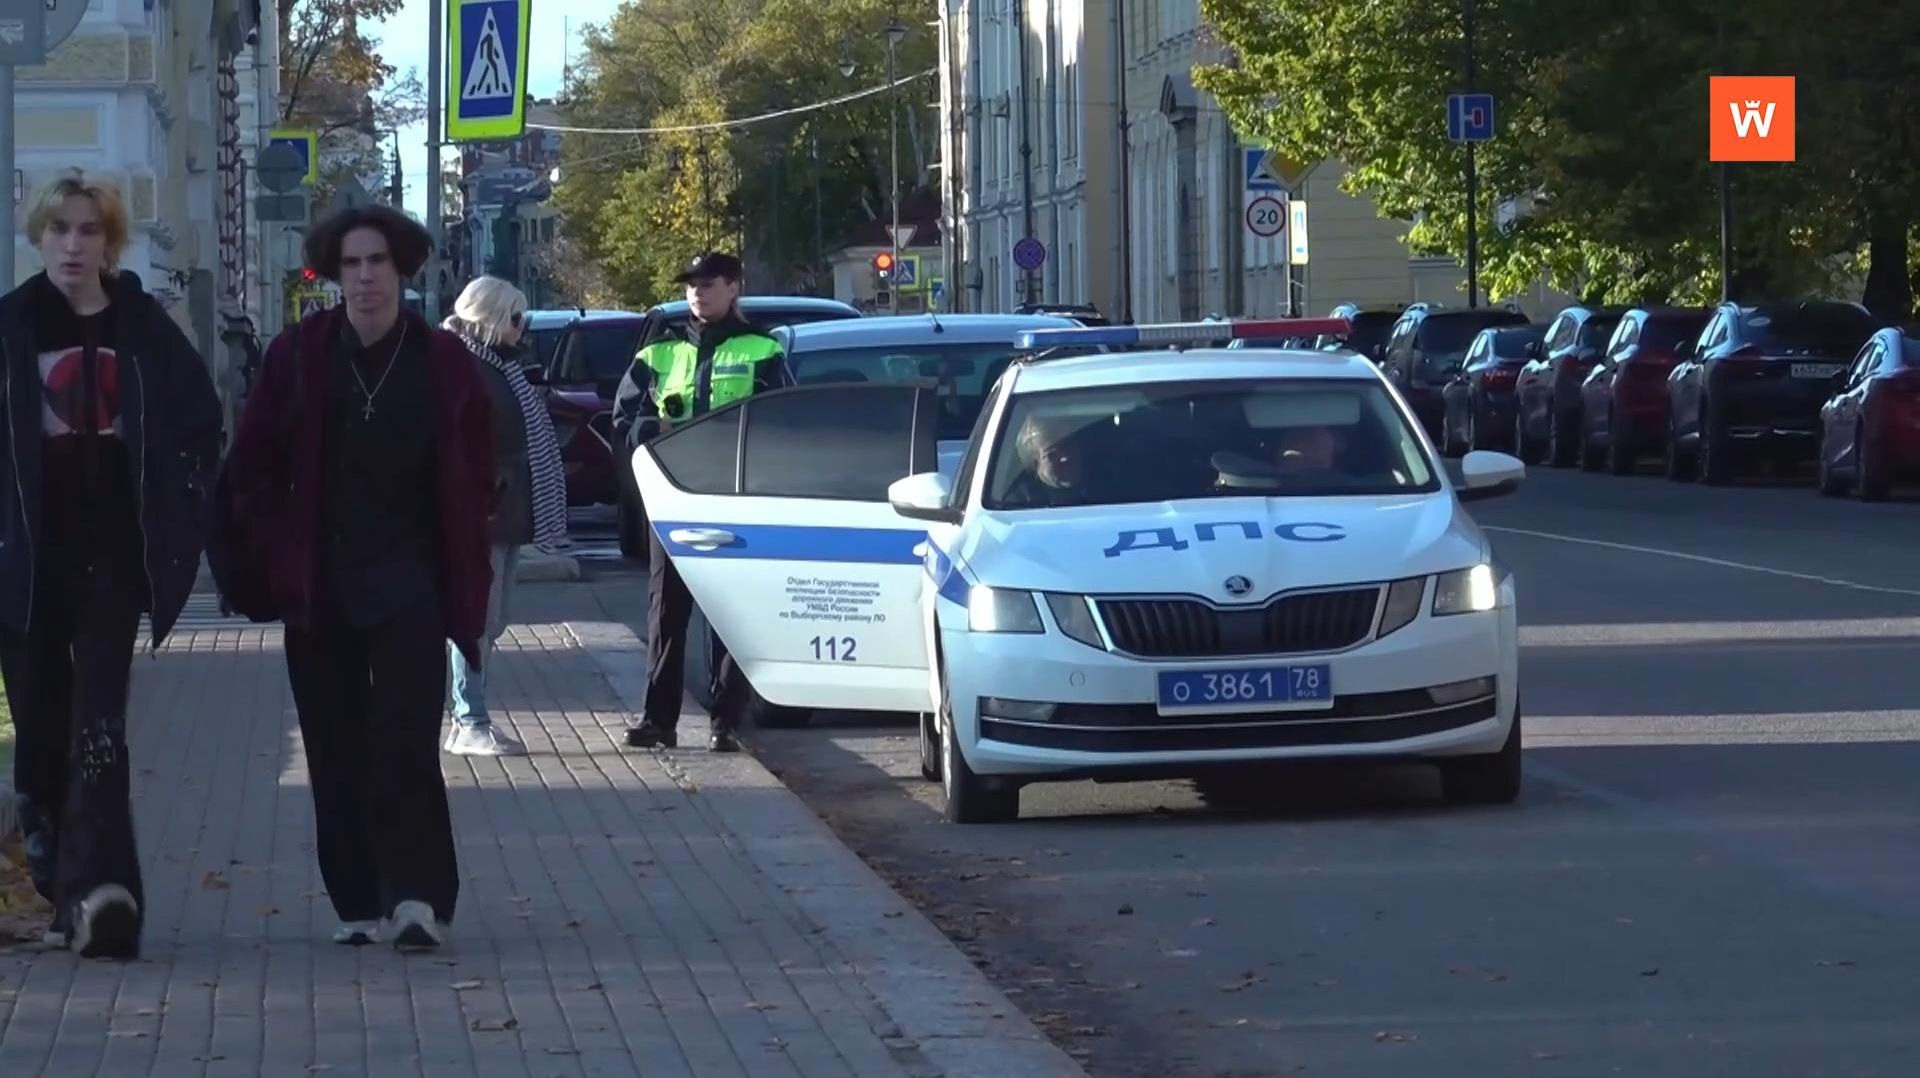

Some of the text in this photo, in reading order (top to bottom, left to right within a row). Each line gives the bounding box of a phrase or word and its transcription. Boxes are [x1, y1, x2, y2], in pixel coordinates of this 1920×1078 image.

[1255, 208, 1279, 225] 20
[1103, 521, 1347, 558] ДПС
[810, 636, 857, 661] 112
[1202, 672, 1273, 701] 3861
[1292, 668, 1320, 689] 78
[1296, 689, 1318, 698] RUS
